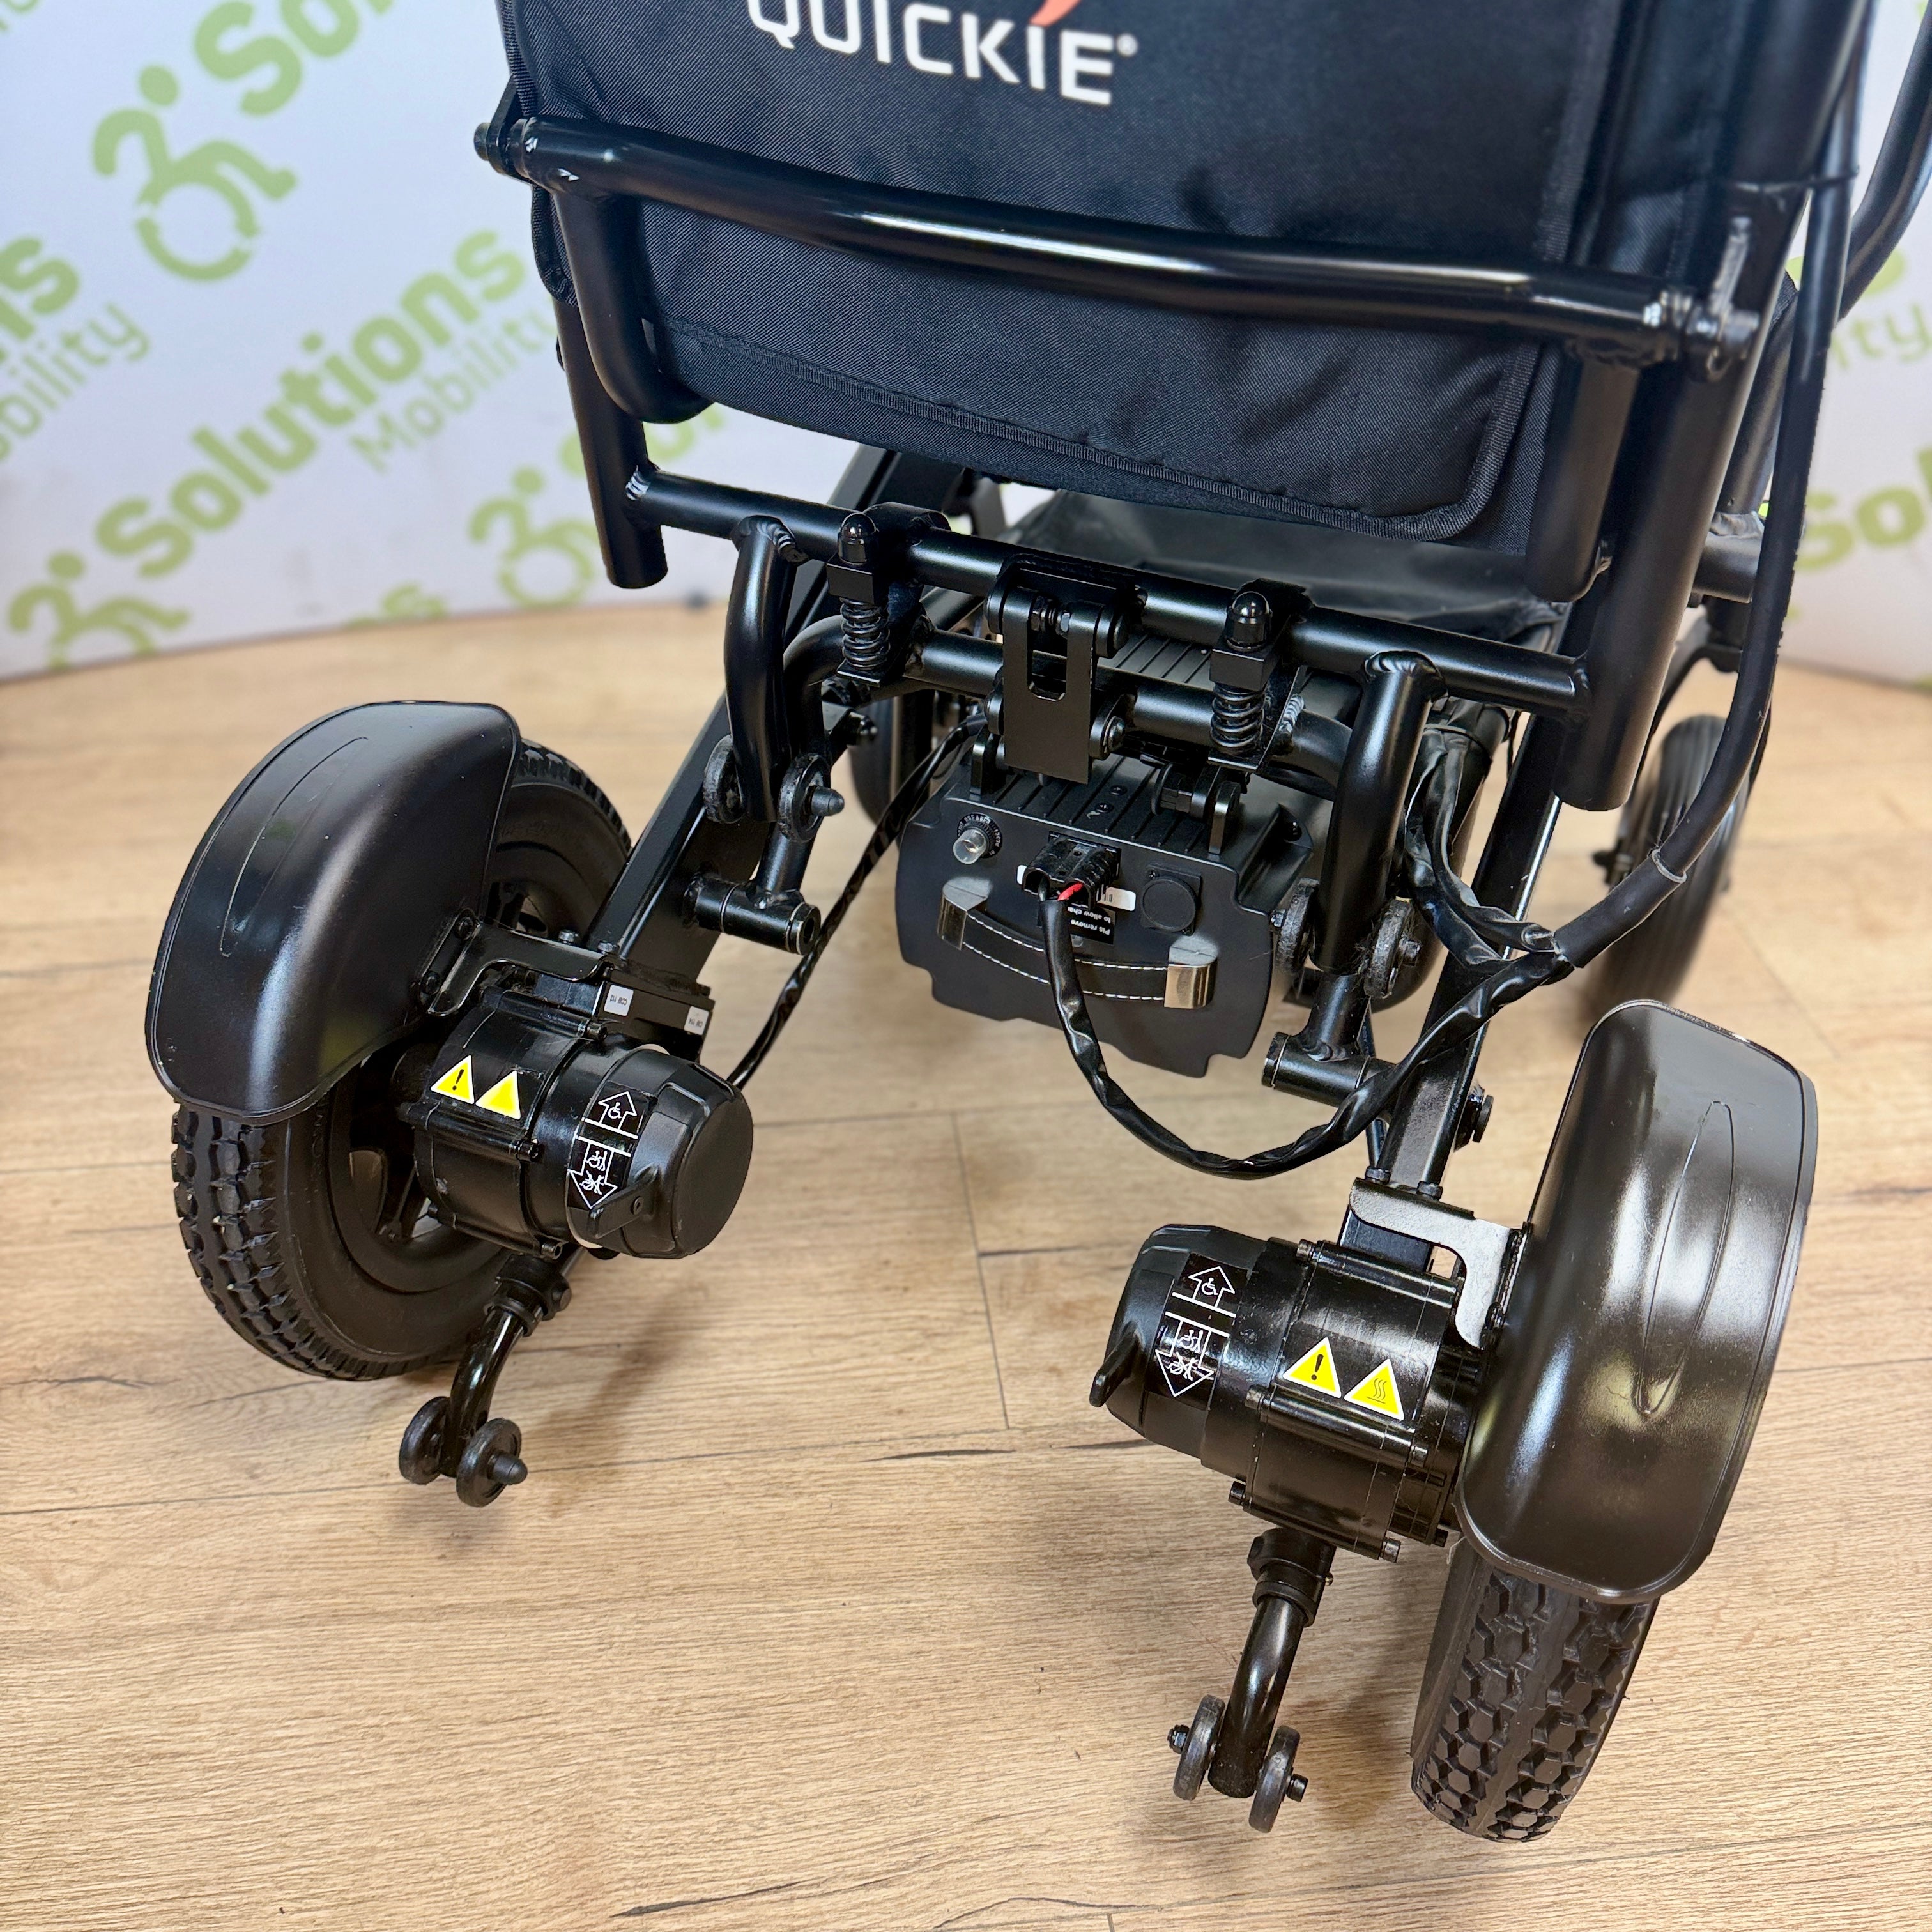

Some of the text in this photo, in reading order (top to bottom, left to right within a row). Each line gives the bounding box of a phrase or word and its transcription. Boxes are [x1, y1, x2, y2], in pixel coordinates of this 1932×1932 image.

[747, 0, 1113, 105] QUICKIE
[95, 230, 525, 578] Solutions
[1070, 919, 1098, 931] remove
[1084, 910, 1103, 920] allow
